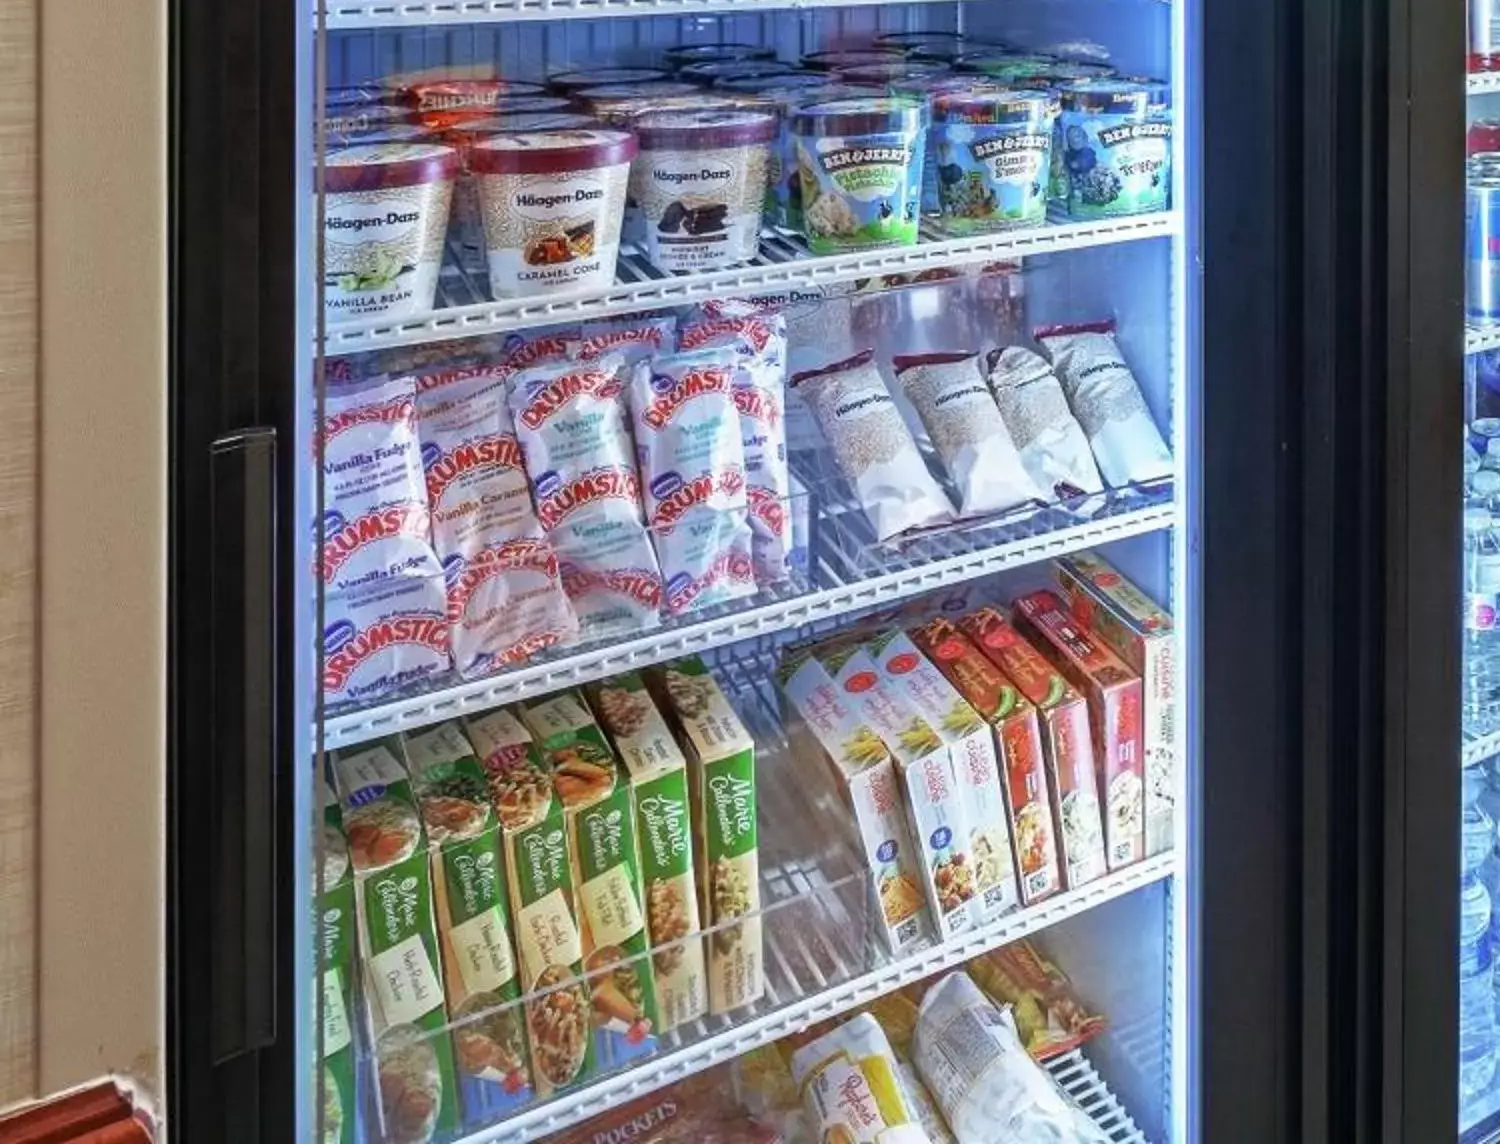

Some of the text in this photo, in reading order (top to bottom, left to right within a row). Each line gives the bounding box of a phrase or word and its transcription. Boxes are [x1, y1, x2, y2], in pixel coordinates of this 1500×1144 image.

[1103, 127, 1130, 144] BEN
[823, 151, 851, 169] BEN
[851, 149, 863, 162] &
[975, 139, 1003, 157] BEN
[516, 188, 604, 208] Häagen-Dazs
[517, 267, 569, 282] CARAMEL
[325, 289, 413, 309] VANILLA BEAN
[679, 414, 724, 436] Vanill
[743, 434, 767, 448] udge
[324, 441, 411, 474] Vanilla Fudge
[434, 499, 481, 524] Vanilla
[338, 569, 389, 590] Vanilla
[324, 617, 454, 693] DRUMSTICK
[347, 674, 395, 698] Vanilla
[728, 772, 752, 836] Marie
[659, 793, 687, 857] Marie
[606, 823, 622, 857] Marie
[548, 843, 562, 881] Marie
[475, 866, 495, 902] Marie
[399, 889, 418, 929] Marie
[592, 1100, 678, 1144] POCKETS
